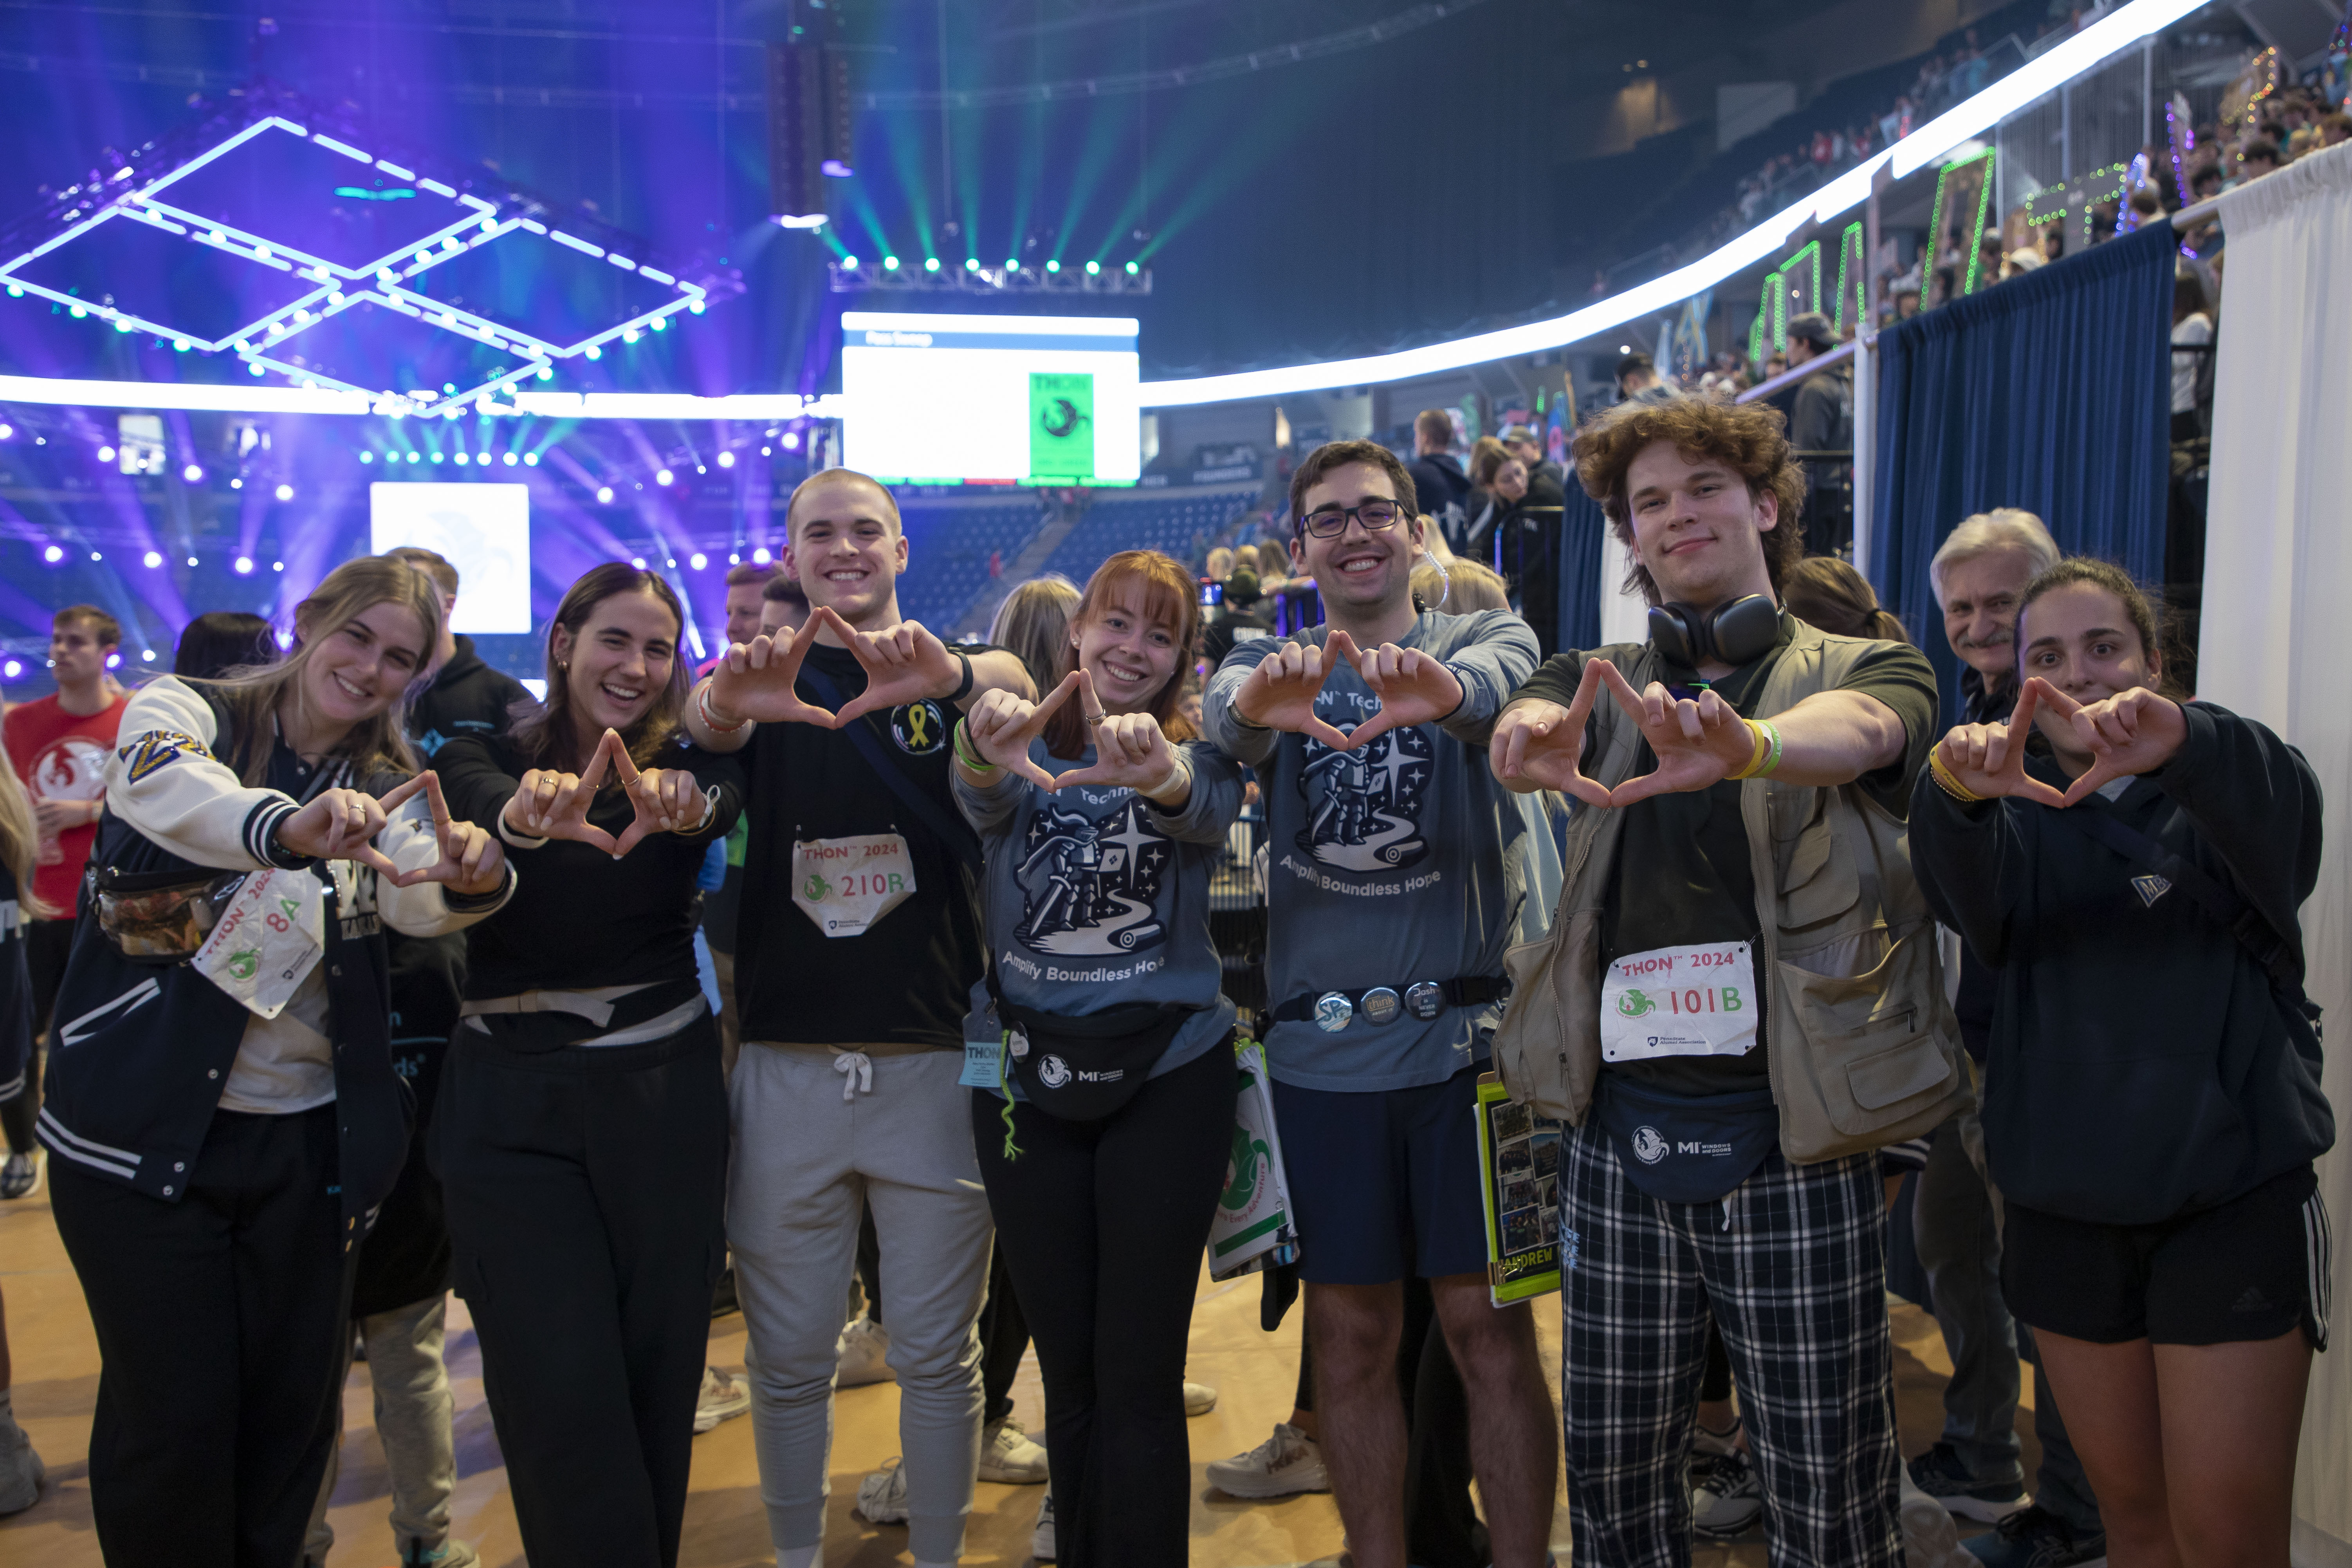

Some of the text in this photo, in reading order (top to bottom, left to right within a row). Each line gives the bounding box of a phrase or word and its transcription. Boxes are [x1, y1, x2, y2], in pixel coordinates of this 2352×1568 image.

[864, 843, 898, 857] 2024
[1320, 875, 1400, 897] Boundless
[1405, 871, 1441, 893] Hope
[266, 899, 302, 933] 8A
[1002, 951, 1165, 982] Amplify Boundless Hoe
[1690, 952, 1734, 967] 2024
[1368, 995, 1394, 1009] think
[1671, 987, 1742, 1015] 101B
[967, 1047, 1000, 1059] THON
[1248, 1162, 1266, 1214] Adventure
[1504, 1247, 1553, 1273] ANDREW
